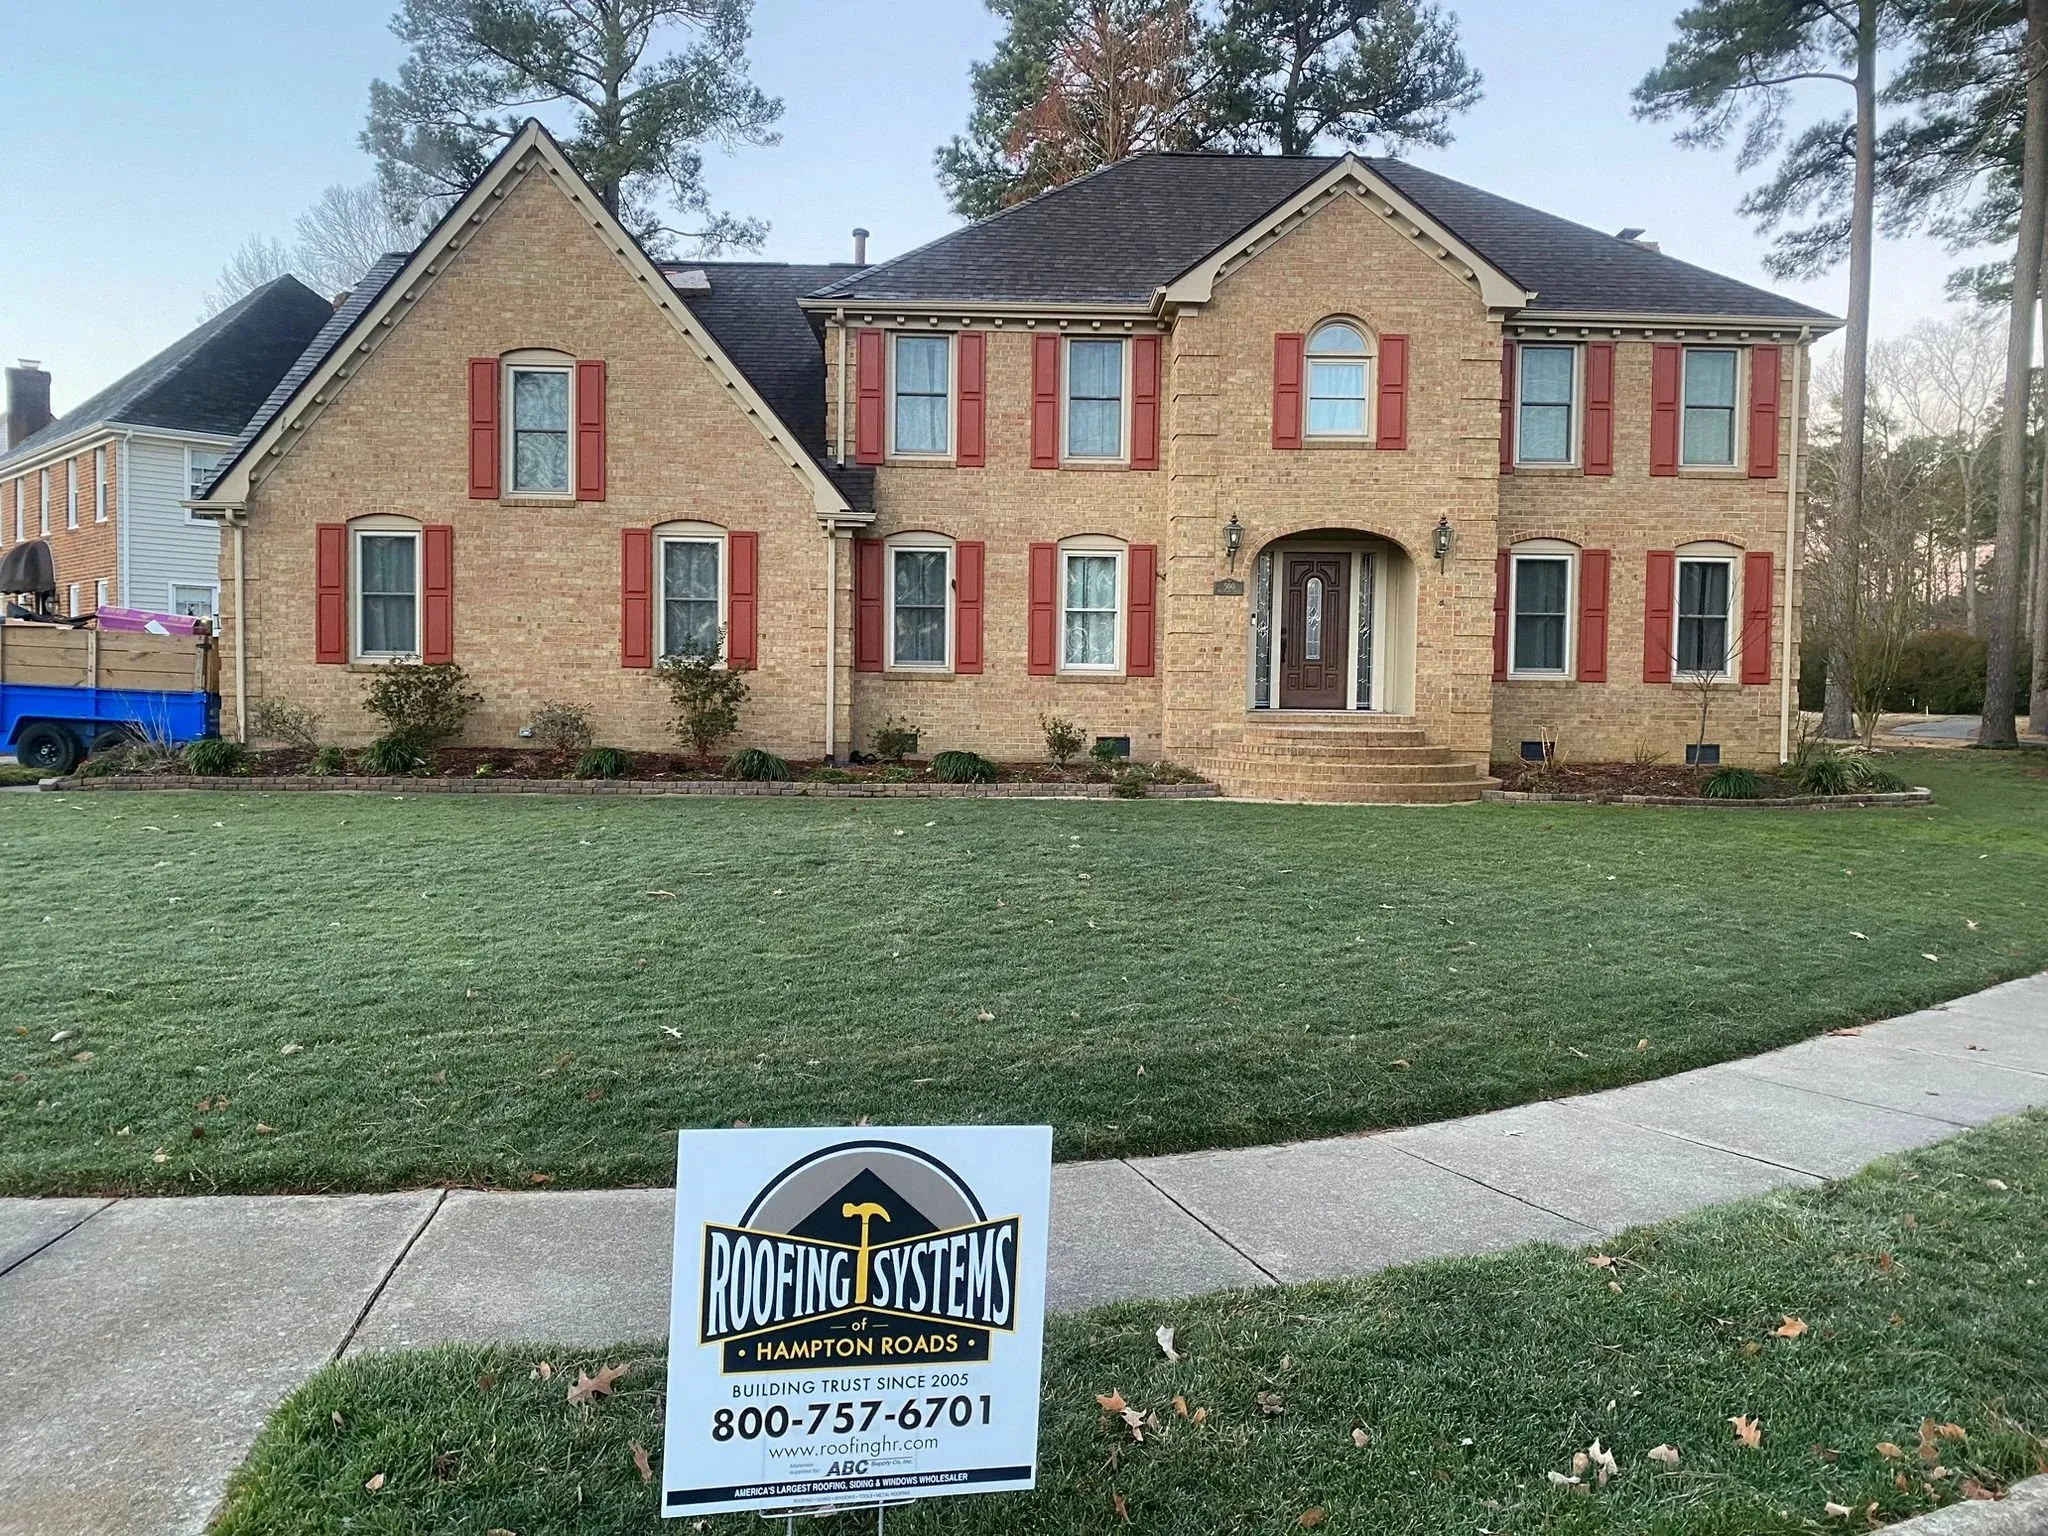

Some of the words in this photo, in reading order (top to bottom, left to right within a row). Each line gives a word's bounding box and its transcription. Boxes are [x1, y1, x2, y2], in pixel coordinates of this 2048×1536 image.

[706, 1231, 850, 1336] ROOFING
[872, 1225, 1013, 1326] SYSTEMS
[851, 1317, 868, 1332] of
[756, 1337, 873, 1361] HAMPTON
[881, 1333, 959, 1355] ROADS
[732, 1380, 816, 1398] BUILDING
[821, 1377, 871, 1393] TRUST
[876, 1375, 926, 1390] SINCE
[931, 1373, 969, 1388] 2005
[712, 1395, 991, 1442] 800-757-6701
[768, 1434, 938, 1459] www.roofinghr.com
[824, 1459, 869, 1477] ABC
[734, 1486, 776, 1498] AMERICA'S
[776, 1483, 812, 1495] LARGEST
[812, 1480, 848, 1492] ROOFING,
[849, 1478, 874, 1489] SIDING
[875, 1478, 881, 1487] &
[882, 1476, 918, 1487] WINDOWS
[918, 1472, 969, 1484] WHOLESALER
